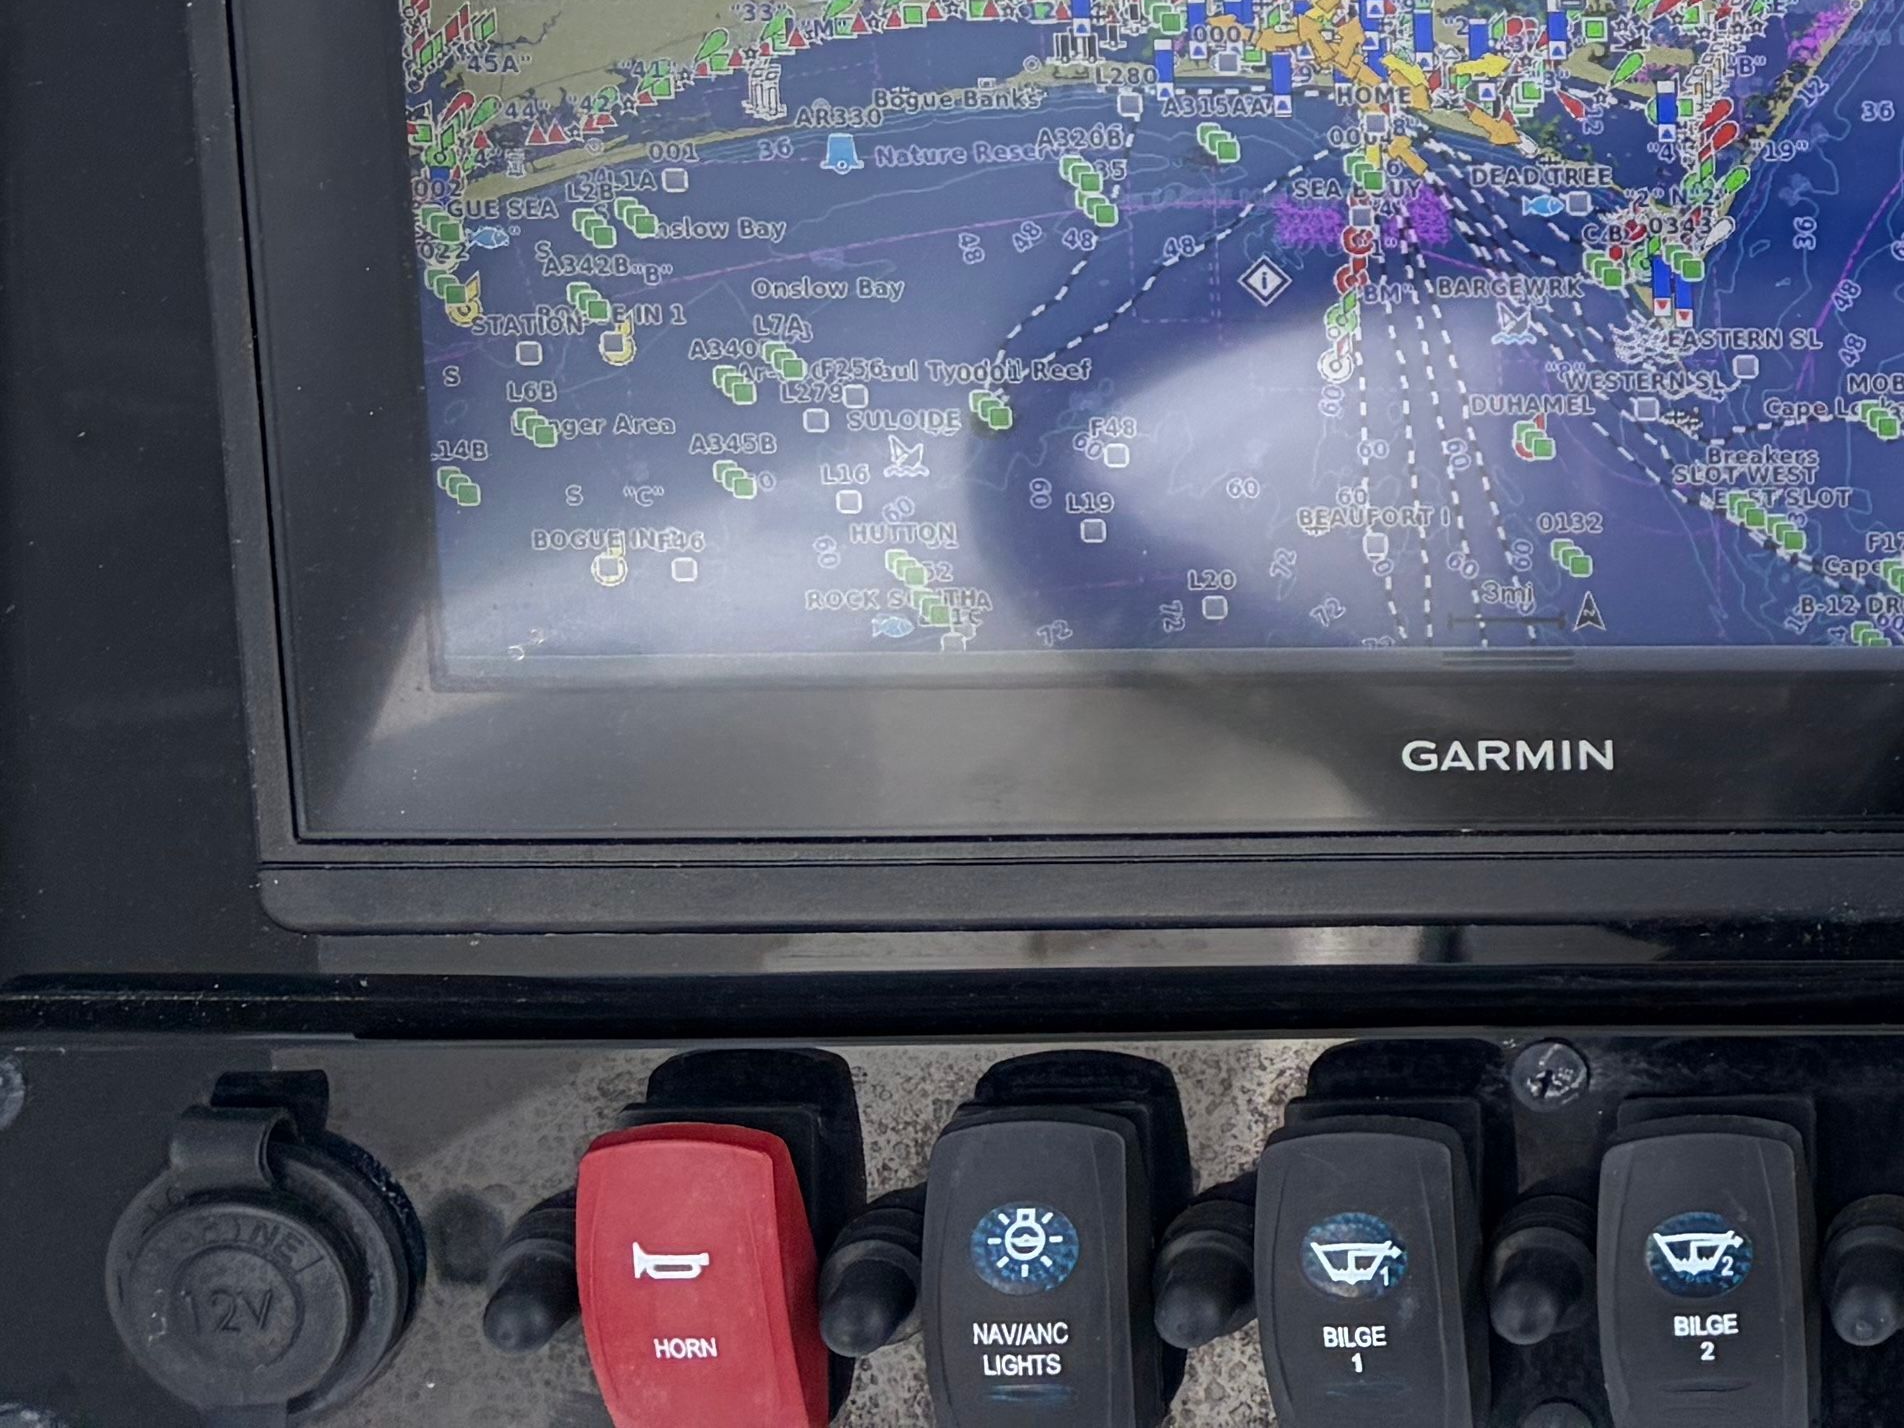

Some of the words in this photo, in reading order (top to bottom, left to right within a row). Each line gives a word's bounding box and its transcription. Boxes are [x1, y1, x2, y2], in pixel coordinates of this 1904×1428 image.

[873, 88, 952, 114] Bogue
[962, 87, 1042, 109] Banks
[1335, 85, 1413, 106] HOME
[795, 107, 883, 128] AR330
[738, 218, 786, 242] Bay
[752, 276, 849, 299] Onslow
[857, 277, 905, 304] Bay
[472, 315, 585, 335] STATION
[1792, 329, 1823, 349] SL
[1471, 394, 1596, 415] DUHAMEL
[1706, 444, 1819, 467] Breakers
[1749, 465, 1819, 485] WEST
[1401, 739, 1614, 772] GARMIN
[185, 1288, 275, 1339] 12V
[1673, 1312, 1739, 1337] BILGE
[972, 1320, 1069, 1347] NAV/ANC
[1322, 1325, 1388, 1349] BILGE
[653, 1335, 718, 1360] HORN
[1700, 1341, 1716, 1361] 2
[983, 1353, 1062, 1377] LIGHTS
[1351, 1353, 1363, 1374] 1
